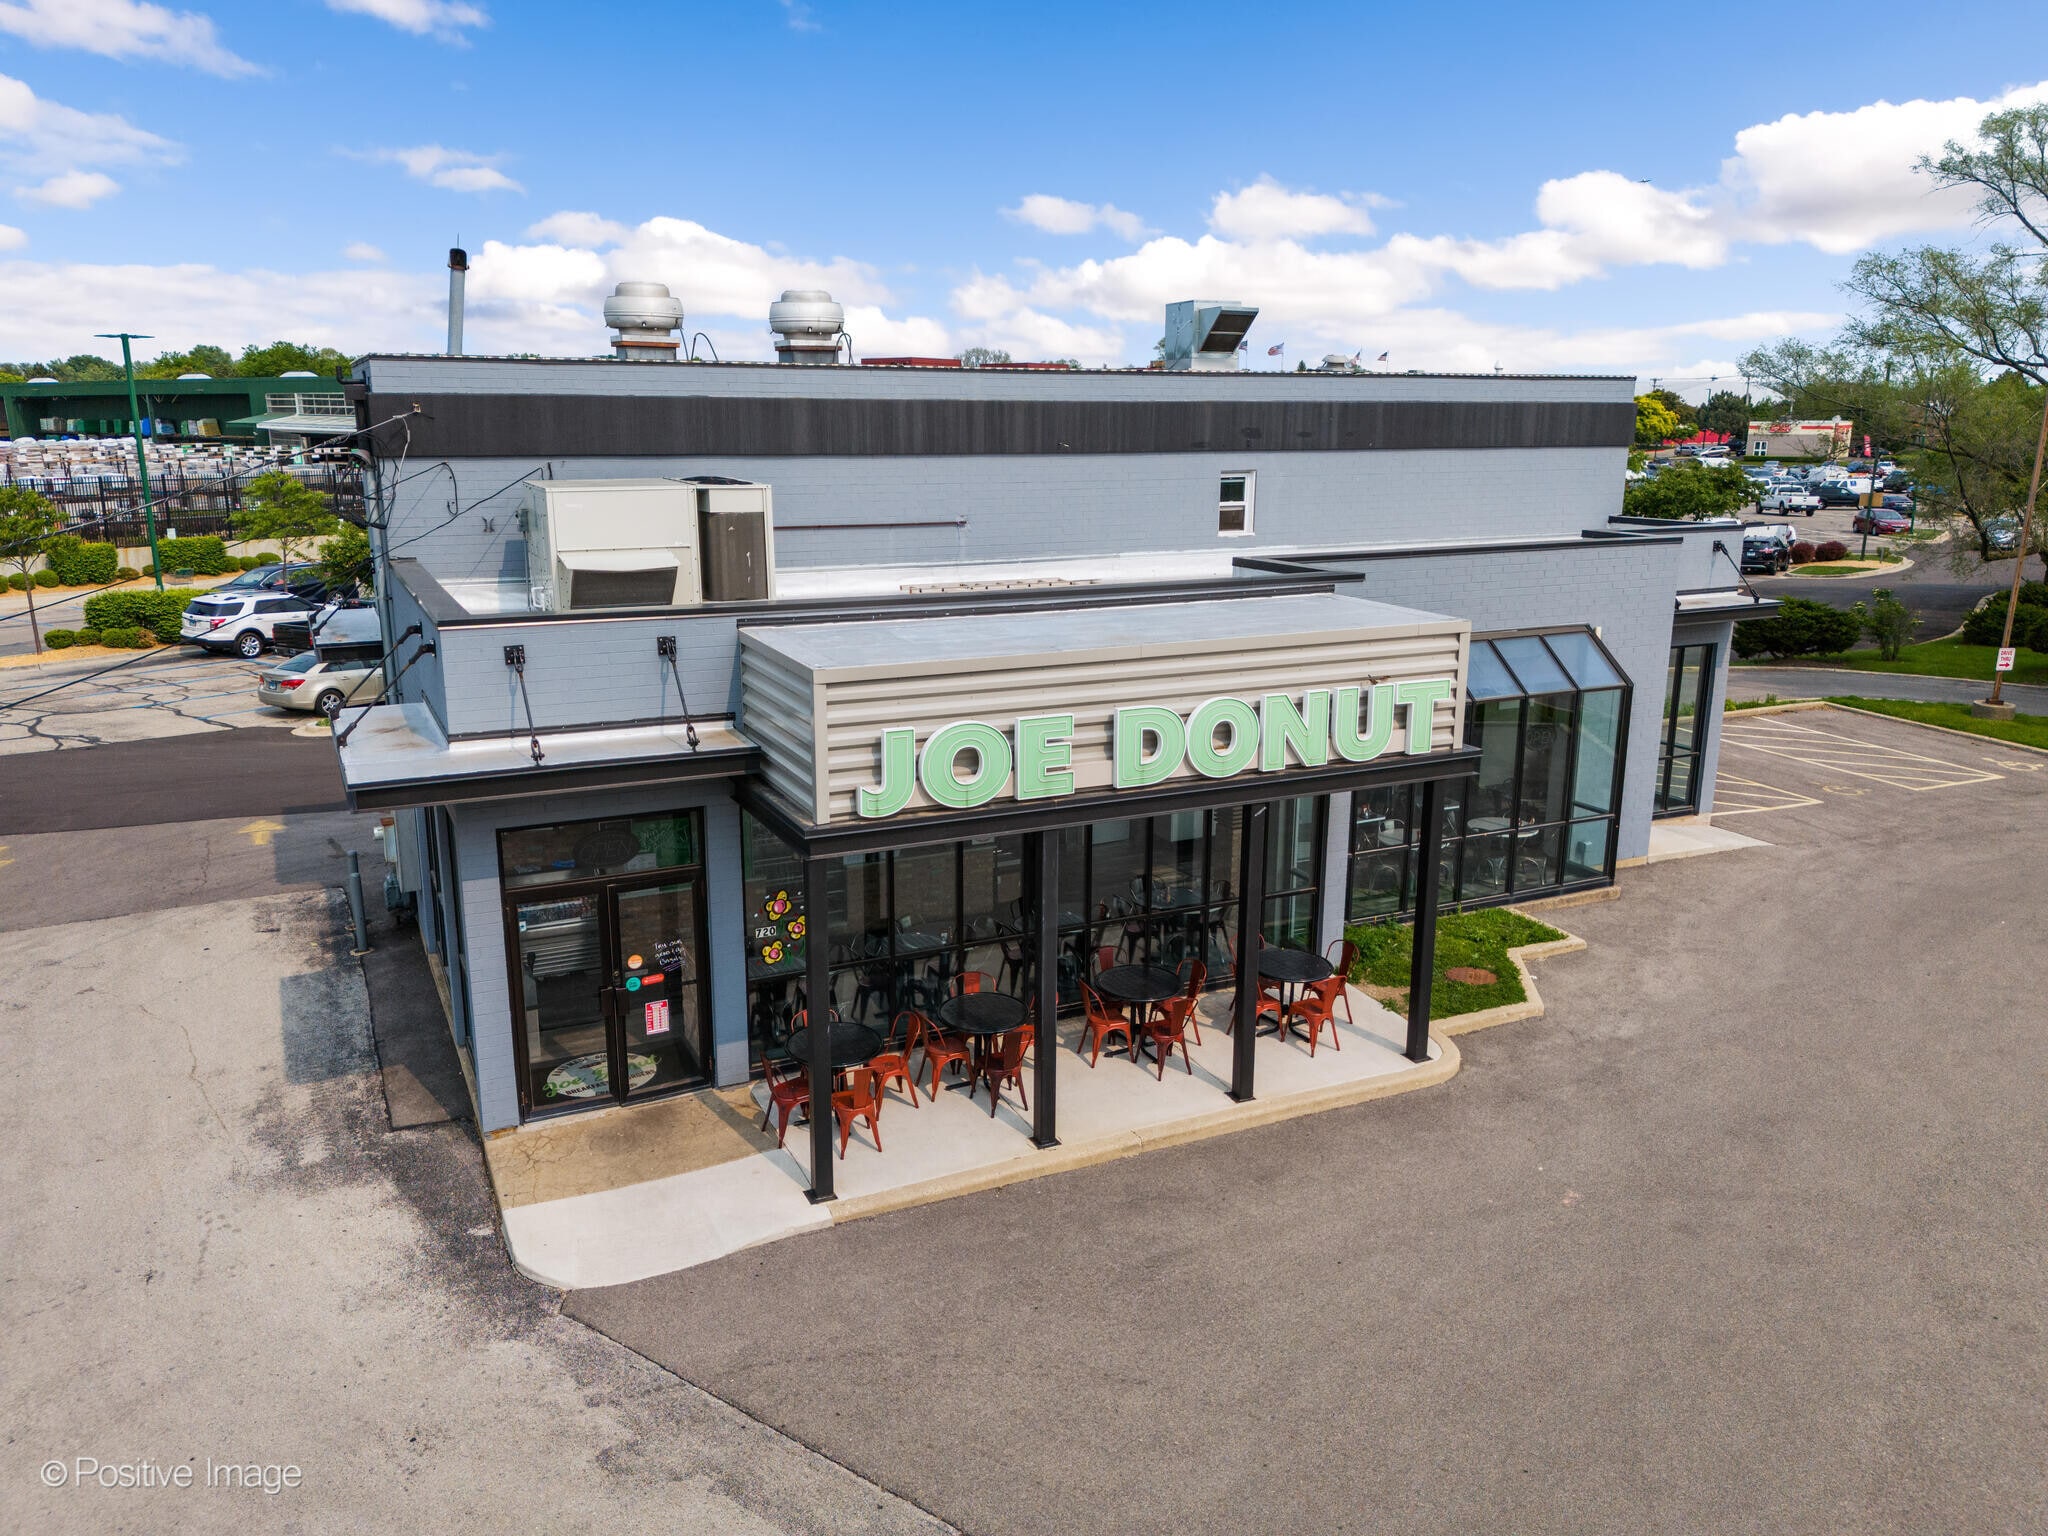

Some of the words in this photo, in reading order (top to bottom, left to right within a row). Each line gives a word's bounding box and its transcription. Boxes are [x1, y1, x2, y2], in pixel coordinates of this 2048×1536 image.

[856, 714, 1076, 818] JOE
[1113, 679, 1453, 789] DONUT
[756, 926, 776, 937] 720
